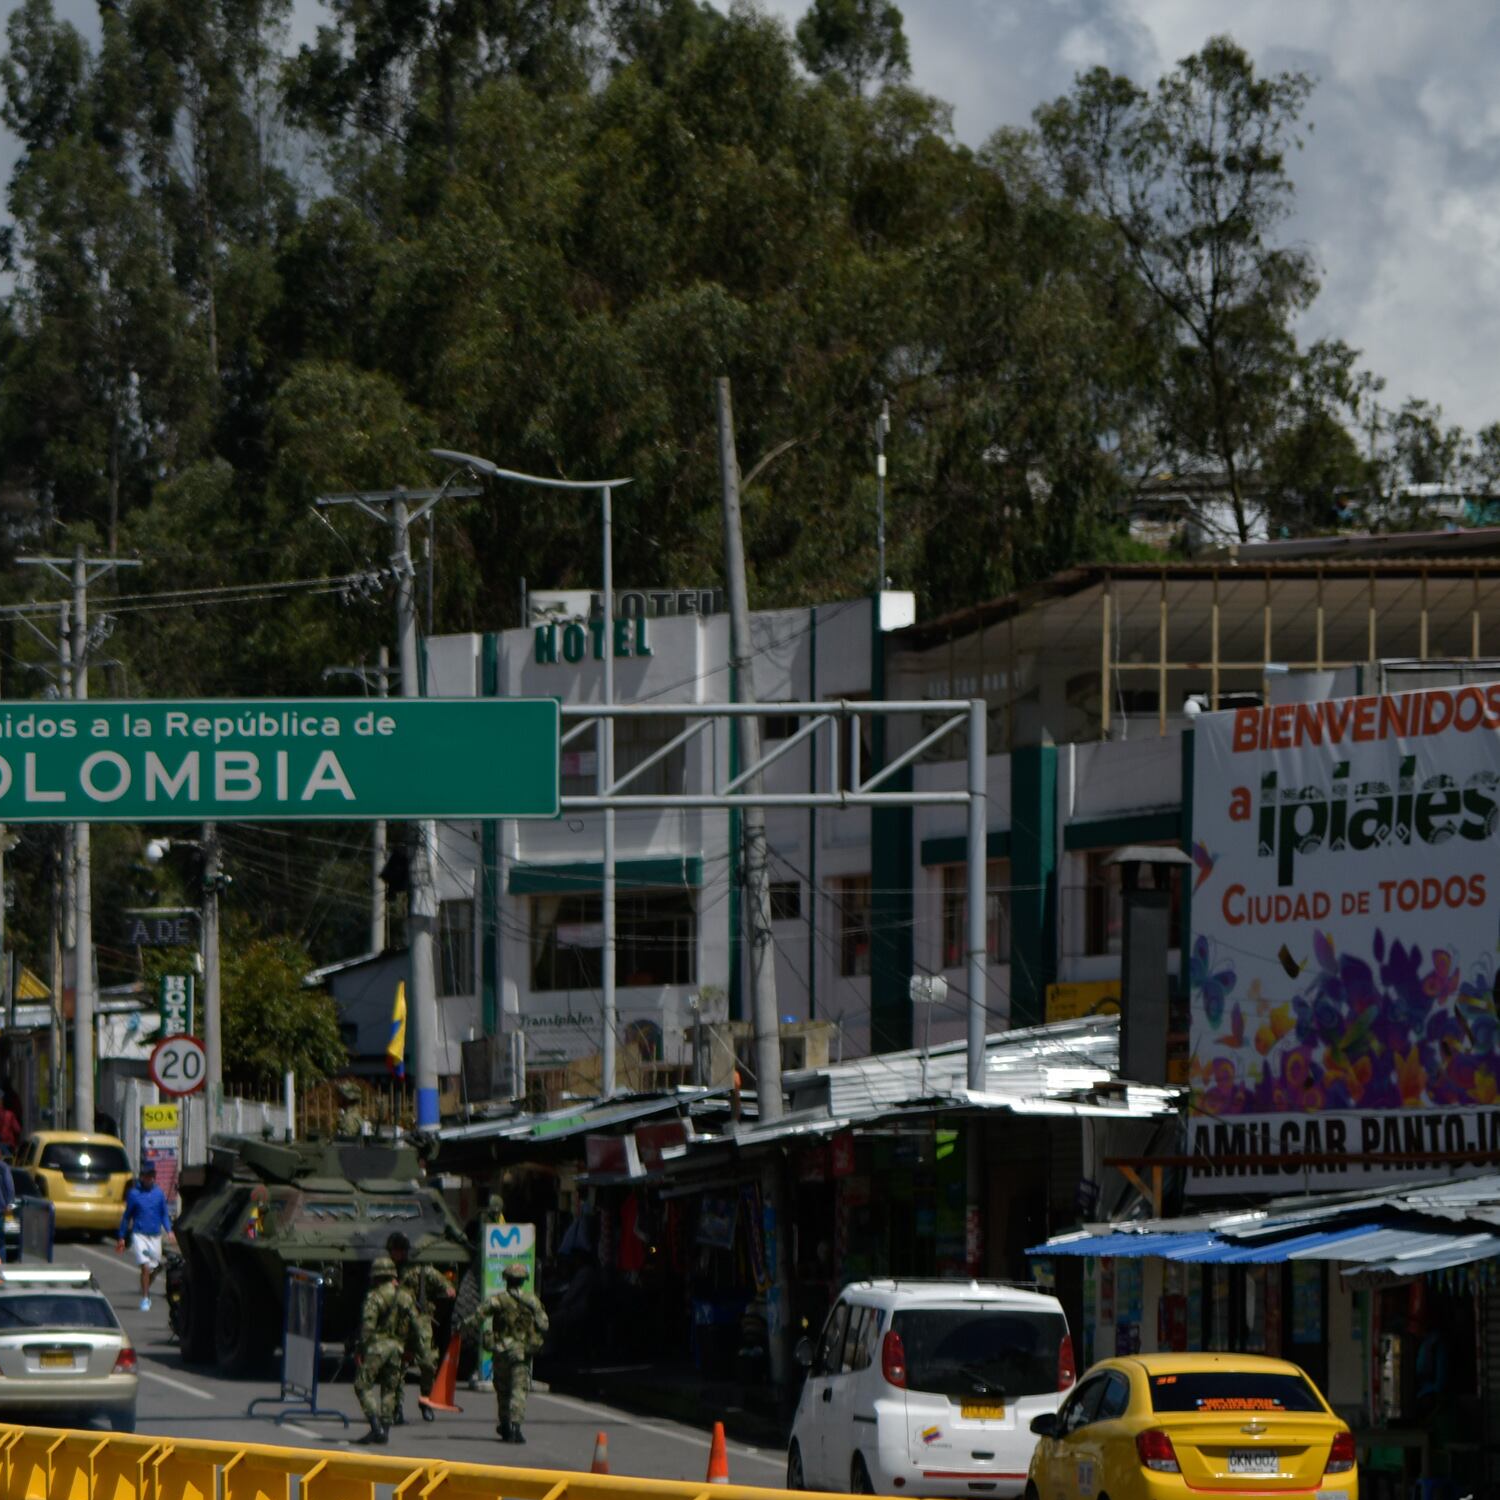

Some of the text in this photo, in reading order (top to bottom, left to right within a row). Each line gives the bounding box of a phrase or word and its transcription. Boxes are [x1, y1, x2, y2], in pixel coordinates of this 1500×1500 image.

[535, 618, 654, 664] HOTEL
[90, 718, 109, 737] a
[123, 713, 152, 737] la
[165, 711, 340, 742] República
[353, 713, 396, 737] de
[1231, 683, 1500, 752] BIENVENIDOS
[1228, 755, 1500, 887] a ipiales
[1341, 892, 1370, 916] DE
[1379, 874, 1487, 912] TODOS
[166, 975, 187, 1036] HOTE
[161, 1051, 201, 1079] 20
[1192, 1119, 1347, 1178] AMILCAR
